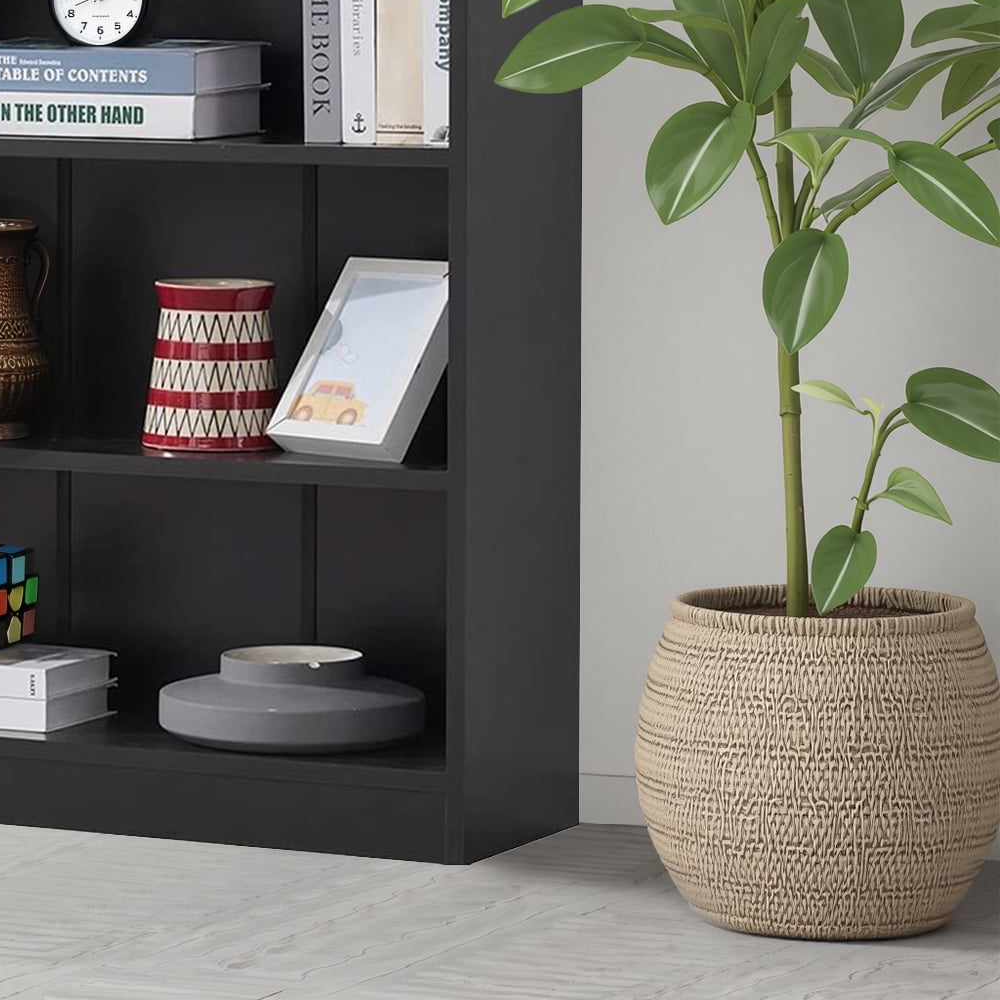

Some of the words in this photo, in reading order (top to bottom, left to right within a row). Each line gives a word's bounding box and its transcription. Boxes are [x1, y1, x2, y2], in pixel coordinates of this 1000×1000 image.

[67, 9, 75, 18] 8
[126, 9, 134, 18] 4
[80, 21, 88, 30] 7
[96, 25, 104, 35] 6
[114, 21, 121, 30] 5
[43, 68, 64, 81] OF
[67, 69, 148, 84] CONTENTS
[311, 34, 331, 115] BOOK
[14, 103, 43, 123] THE
[46, 104, 97, 124] OTHER
[100, 105, 144, 125] HAND
